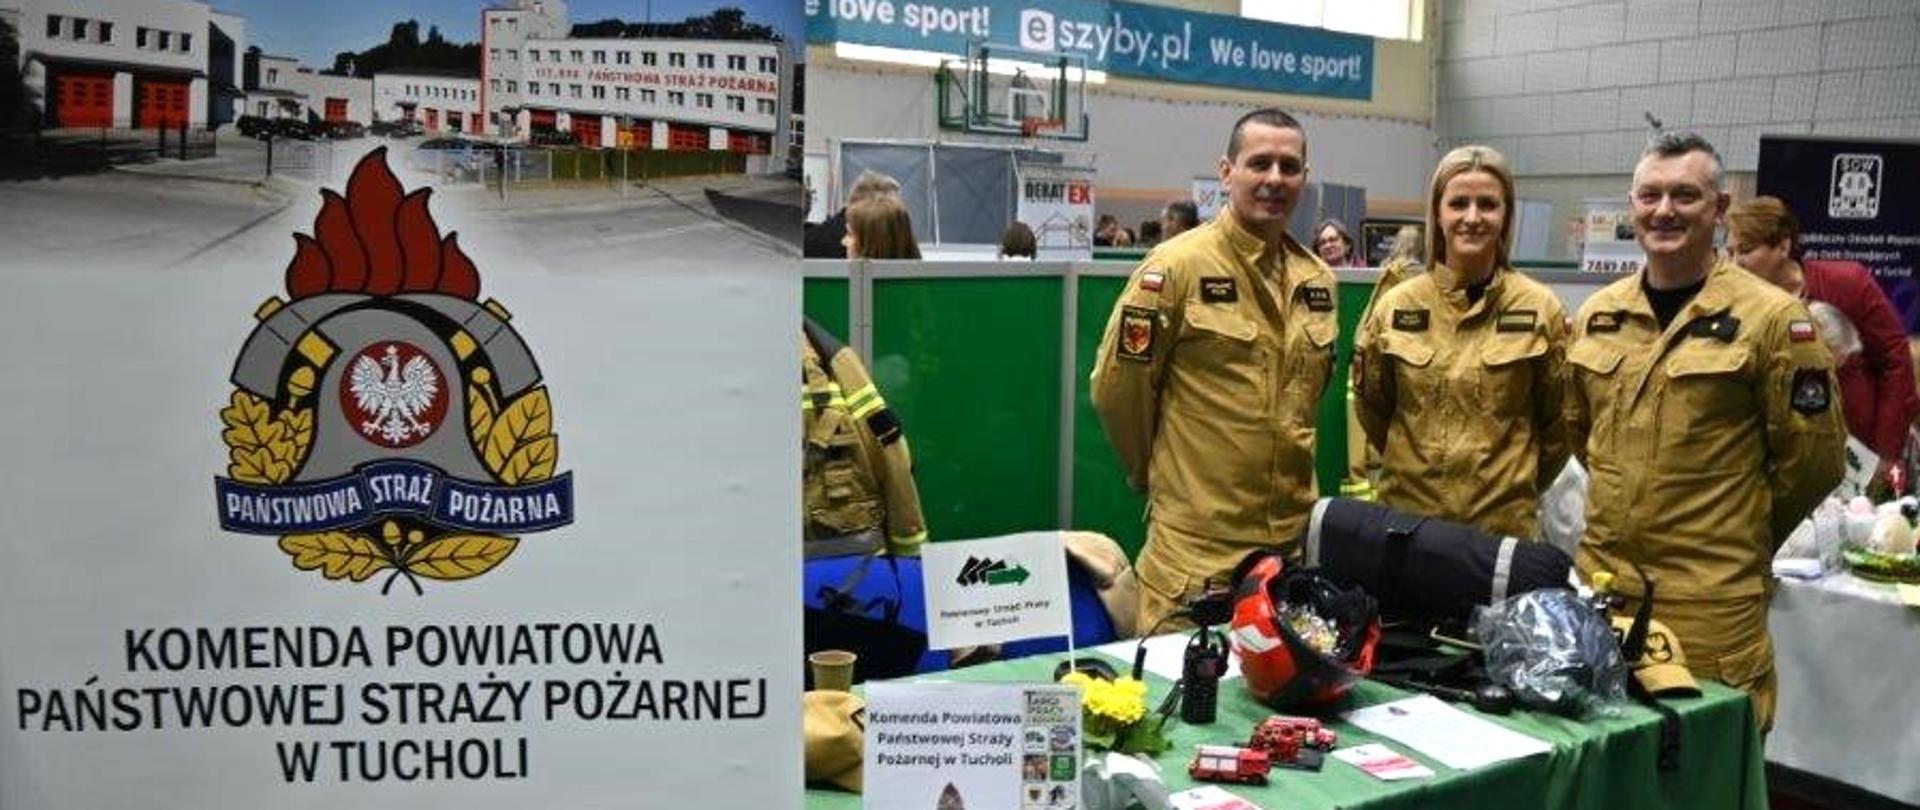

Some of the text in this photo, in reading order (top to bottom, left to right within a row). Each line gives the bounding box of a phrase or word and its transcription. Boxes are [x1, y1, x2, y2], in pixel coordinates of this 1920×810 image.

[829, 0, 894, 24] love
[904, 3, 990, 36] sport!
[1211, 37, 1361, 81] We love sport!
[709, 75, 777, 94] POŻARNA
[226, 472, 560, 524] PAŃSTWOWA STRAŻ POŻARNA
[125, 623, 663, 671] KOMENDA POWIATOWA
[18, 669, 768, 731] PAŃSTWOWEJ STRAŻY POŻARNEJ
[869, 711, 938, 724] Komenda
[942, 712, 1022, 724] Powiatowa
[277, 737, 530, 783] W TUCHOLI
[877, 732, 1014, 748] Państwowej Straży
[877, 752, 1013, 769] Pożarnej w Tucholi
